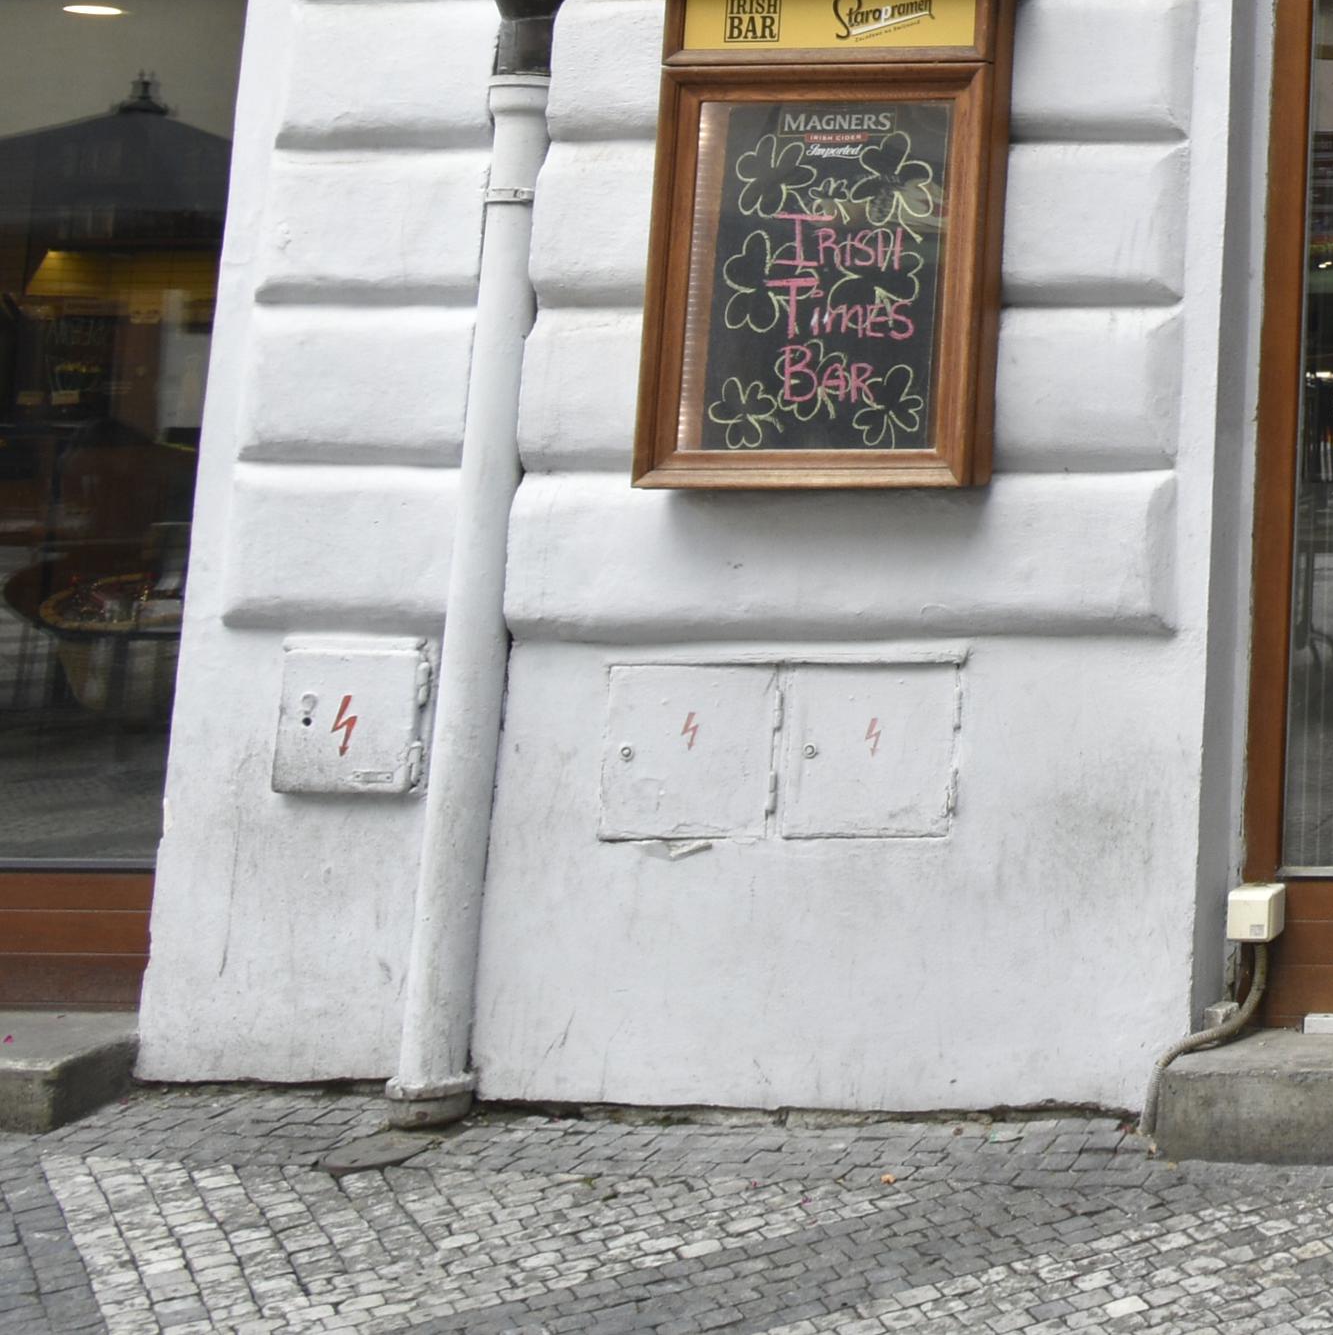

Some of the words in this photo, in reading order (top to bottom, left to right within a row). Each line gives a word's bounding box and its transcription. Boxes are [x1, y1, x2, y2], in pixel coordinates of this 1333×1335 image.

[727, 16, 777, 39] BAR
[784, 113, 891, 131] MAGNERS
[806, 144, 862, 158] Imported
[780, 345, 874, 403] BAR
